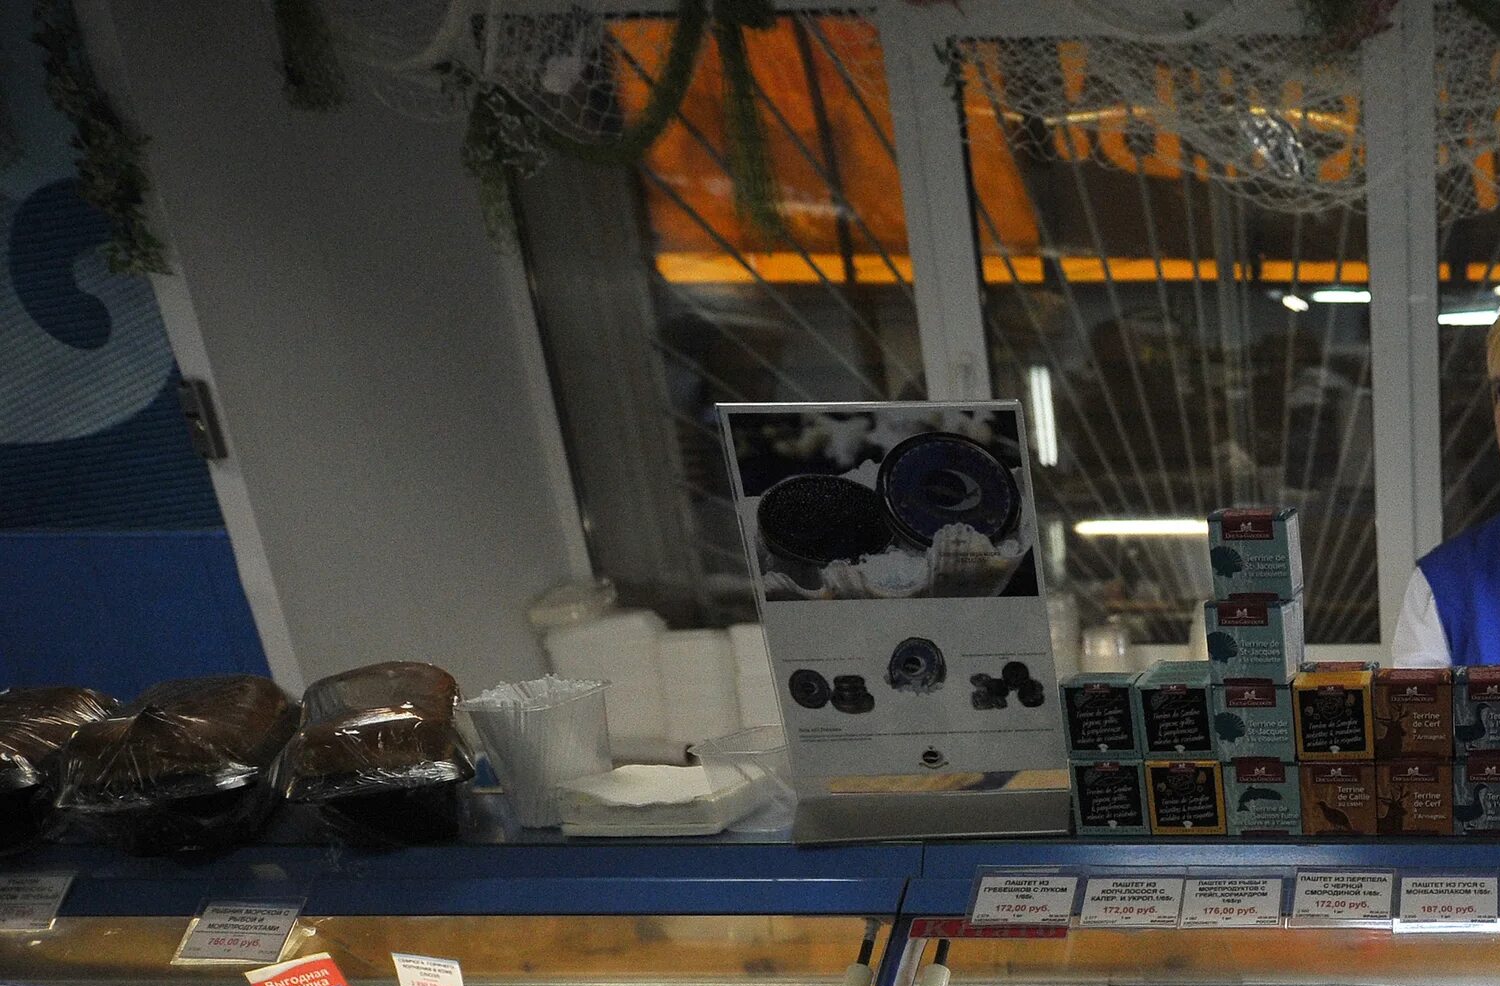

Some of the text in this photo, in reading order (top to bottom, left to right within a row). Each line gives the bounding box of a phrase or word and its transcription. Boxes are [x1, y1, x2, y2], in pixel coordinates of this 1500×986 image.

[1029, 905, 1050, 913] руб.
[1348, 901, 1370, 909] руб.
[1103, 906, 1157, 914] 172,00 руб.
[1237, 907, 1258, 915] руб.
[1455, 906, 1477, 914] руб.
